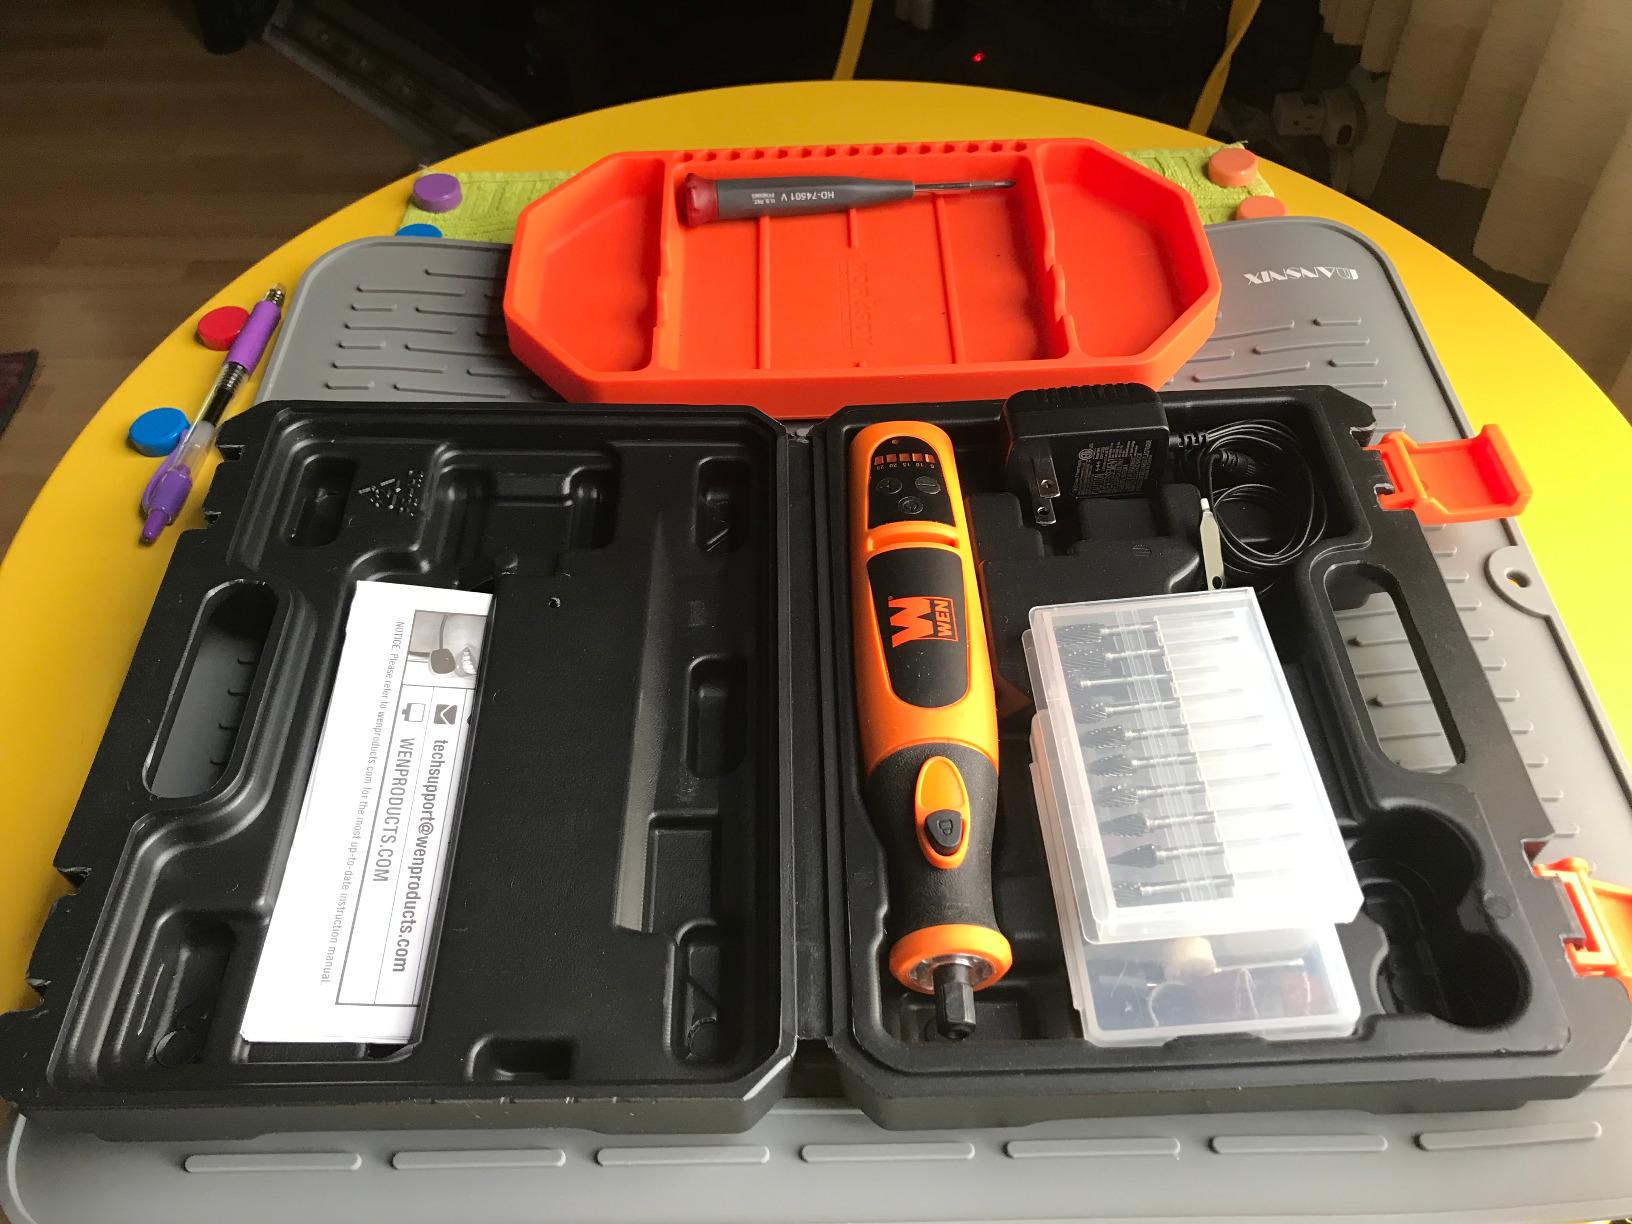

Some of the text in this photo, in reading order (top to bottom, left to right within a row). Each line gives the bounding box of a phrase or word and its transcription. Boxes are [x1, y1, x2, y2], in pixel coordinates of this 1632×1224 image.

[781, 191, 835, 201] HD-74501 V
[934, 600, 953, 636] WEN
[392, 621, 405, 653] NOTICE:
[385, 653, 399, 679] Please
[381, 680, 392, 699] refer
[379, 701, 388, 710] to
[366, 711, 384, 784] wenproducts.com
[361, 786, 371, 799] for
[357, 801, 368, 815] the
[373, 738, 415, 882] WENPRODUCTS.COM
[352, 817, 364, 840] most
[341, 842, 357, 890] up-to-date
[392, 739, 448, 972] techsupport@wenproducts.com
[330, 893, 348, 943] instruction
